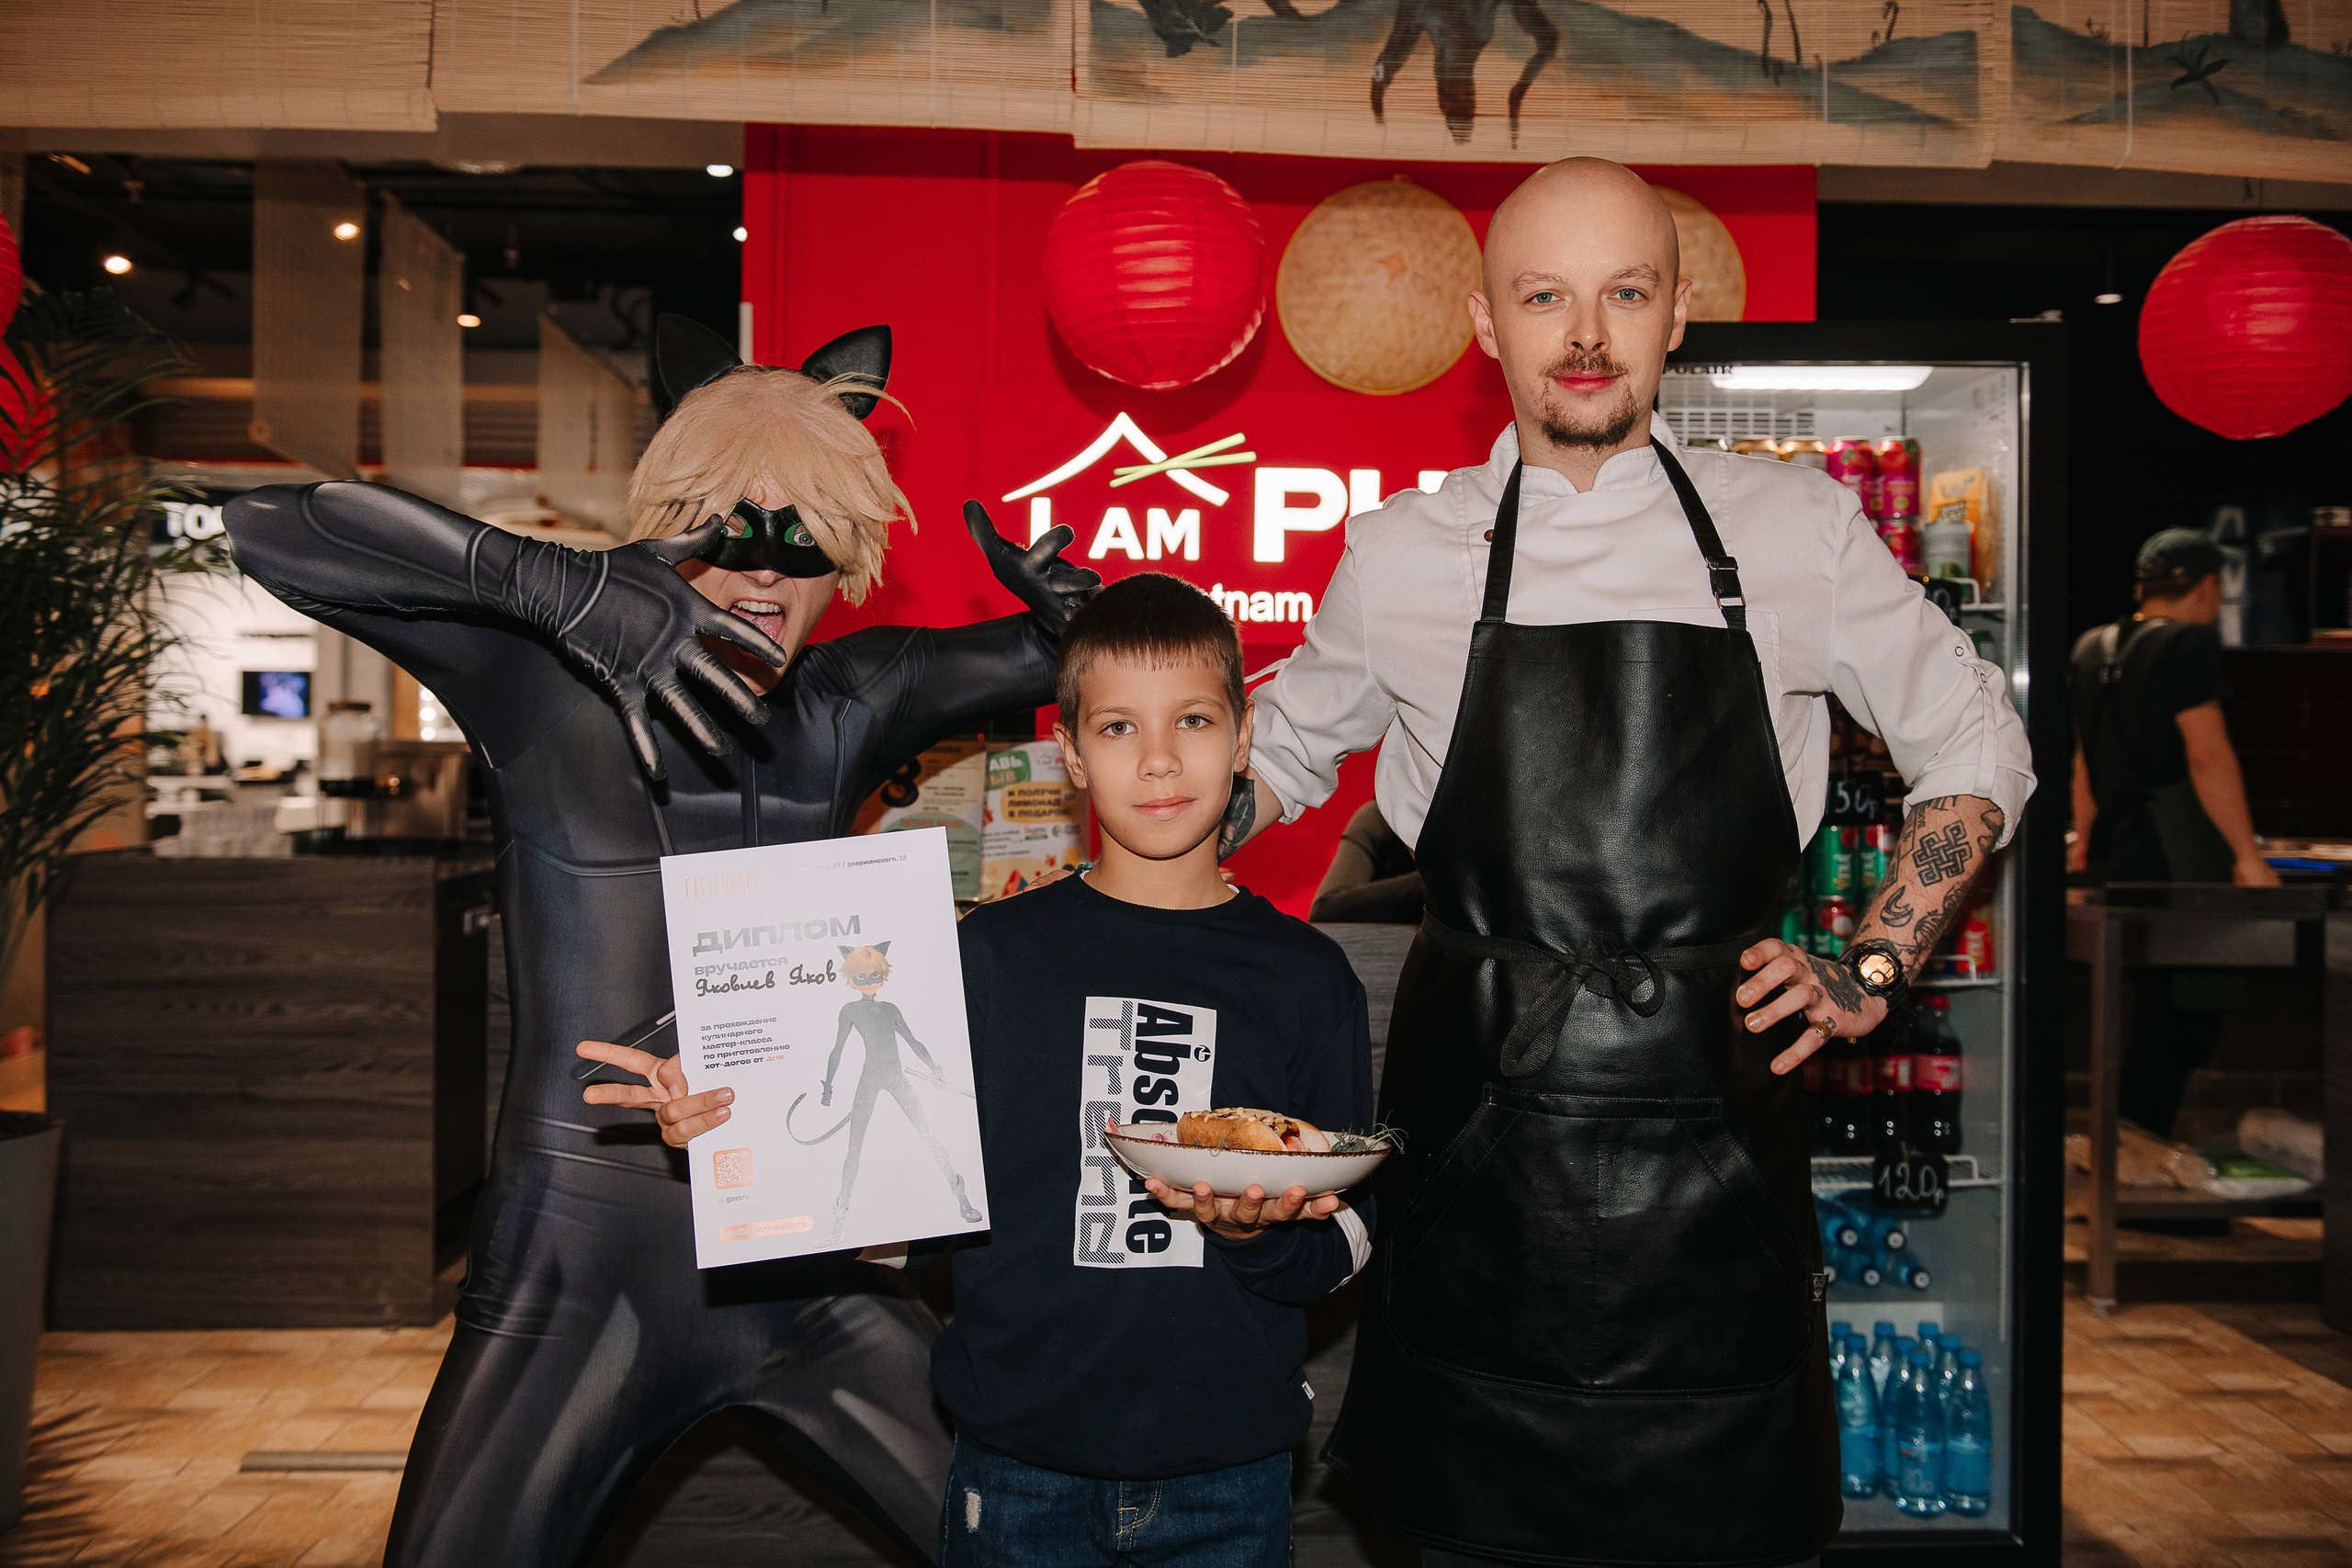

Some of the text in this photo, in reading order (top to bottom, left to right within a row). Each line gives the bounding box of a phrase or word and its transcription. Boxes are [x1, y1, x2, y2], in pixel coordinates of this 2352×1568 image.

[1088, 506, 1201, 561] AM
[1204, 581, 1313, 623] tnam
[695, 956, 788, 977] вручается
[789, 959, 837, 986] Яков
[713, 1017, 777, 1031] прохождение
[701, 1028, 763, 1041] кулинарного
[702, 1036, 773, 1050] мастер-класса
[717, 1043, 790, 1060] приготовлению
[705, 1059, 752, 1070] хот-догов
